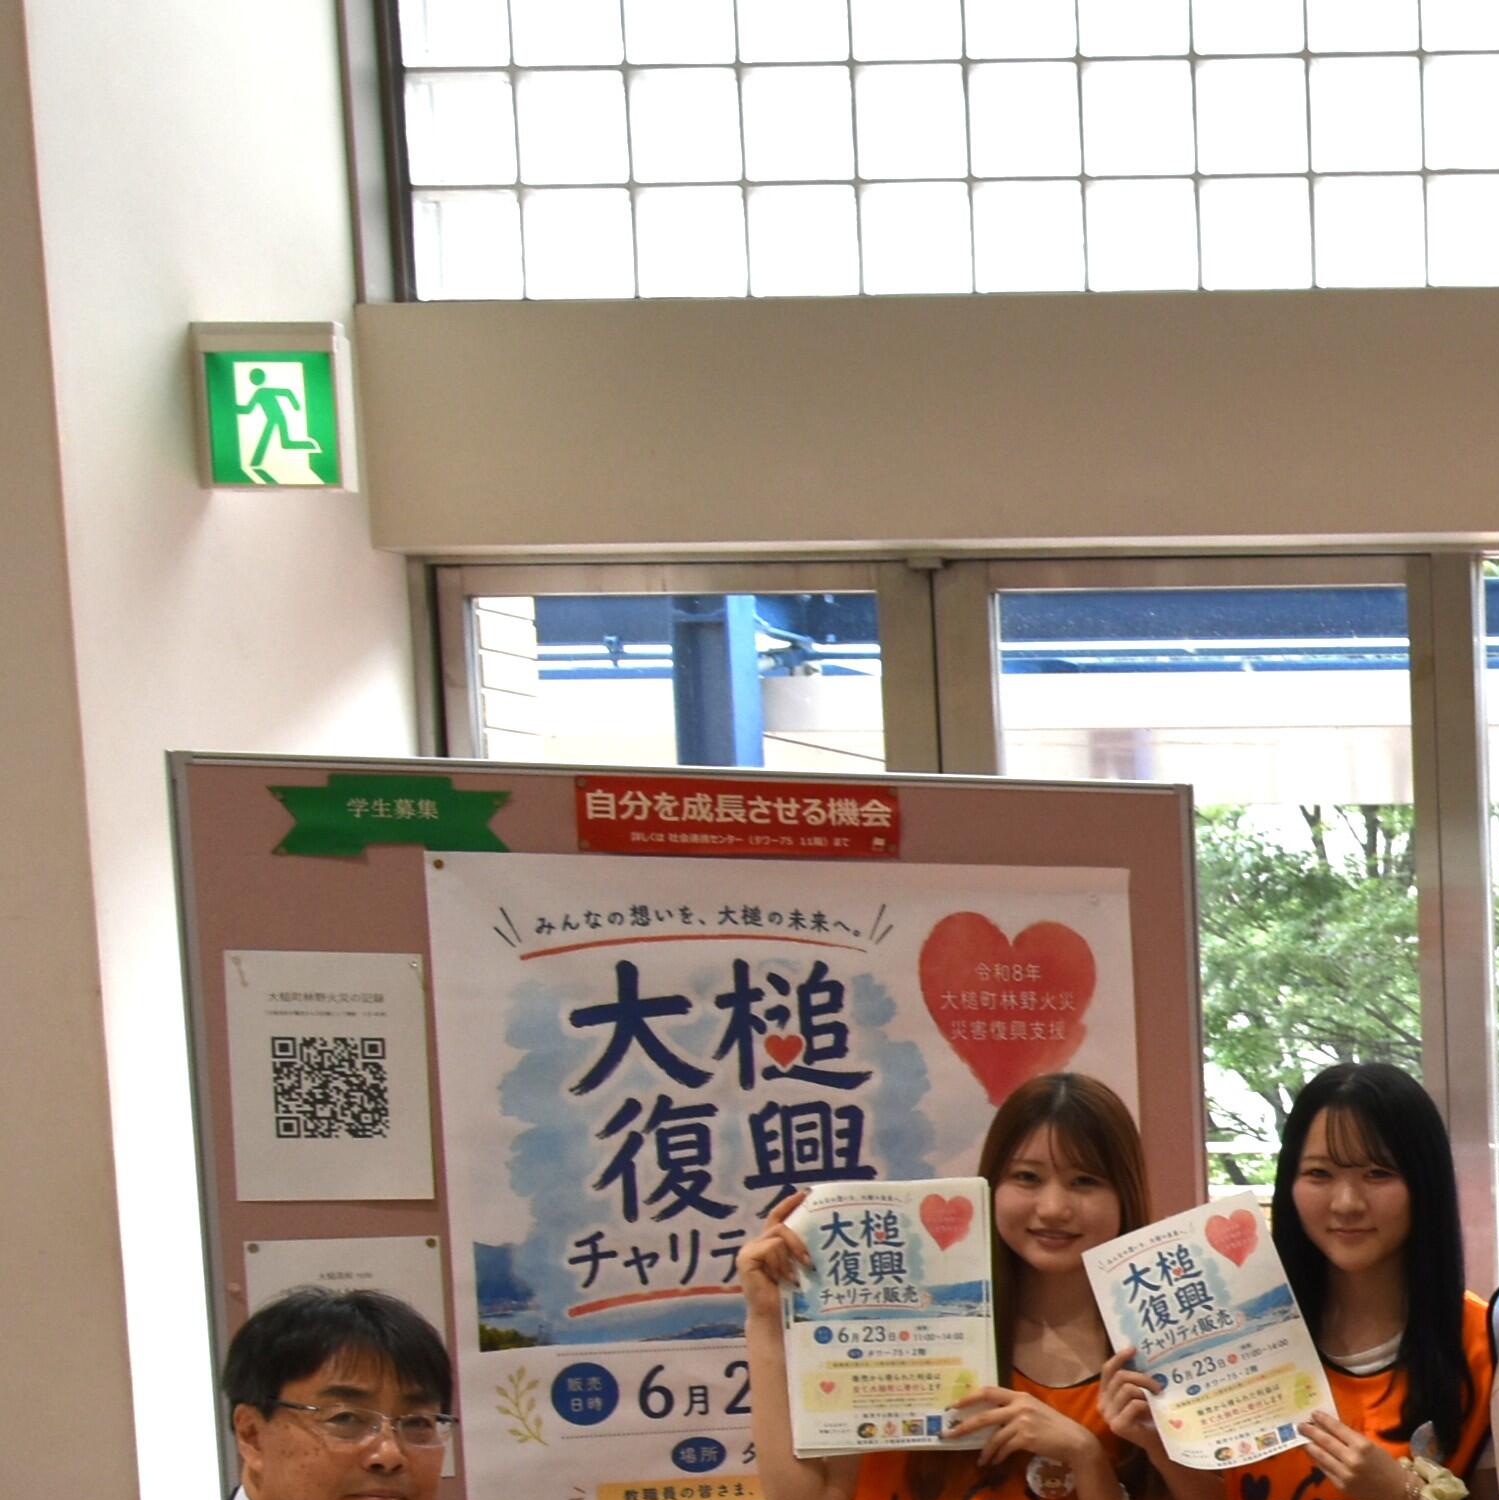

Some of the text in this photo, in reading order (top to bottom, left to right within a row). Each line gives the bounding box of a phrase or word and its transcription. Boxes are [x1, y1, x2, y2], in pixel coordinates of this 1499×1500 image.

[346, 798, 439, 820] 学生募集
[585, 790, 893, 828] 自分を成長させる機会
[535, 904, 862, 937] みんなの想いを、大槌の未来へ。
[974, 962, 1041, 982] 令和8年
[940, 991, 1077, 1011] 大槌町林野火災
[568, 959, 874, 1094] 大槌
[950, 1020, 1066, 1041] 災害復興支援
[592, 1096, 877, 1223] 復興
[821, 1209, 905, 1250] 大槌
[827, 1250, 906, 1286] 復興
[1123, 1244, 1202, 1302] 大槌
[819, 1286, 919, 1304] チャリティ販売
[1138, 1280, 1214, 1332] 復興
[1141, 1311, 1234, 1354] チャリティ販売
[566, 1376, 603, 1393] 販売
[570, 1396, 603, 1412] 日時
[679, 1445, 719, 1464] 場所
